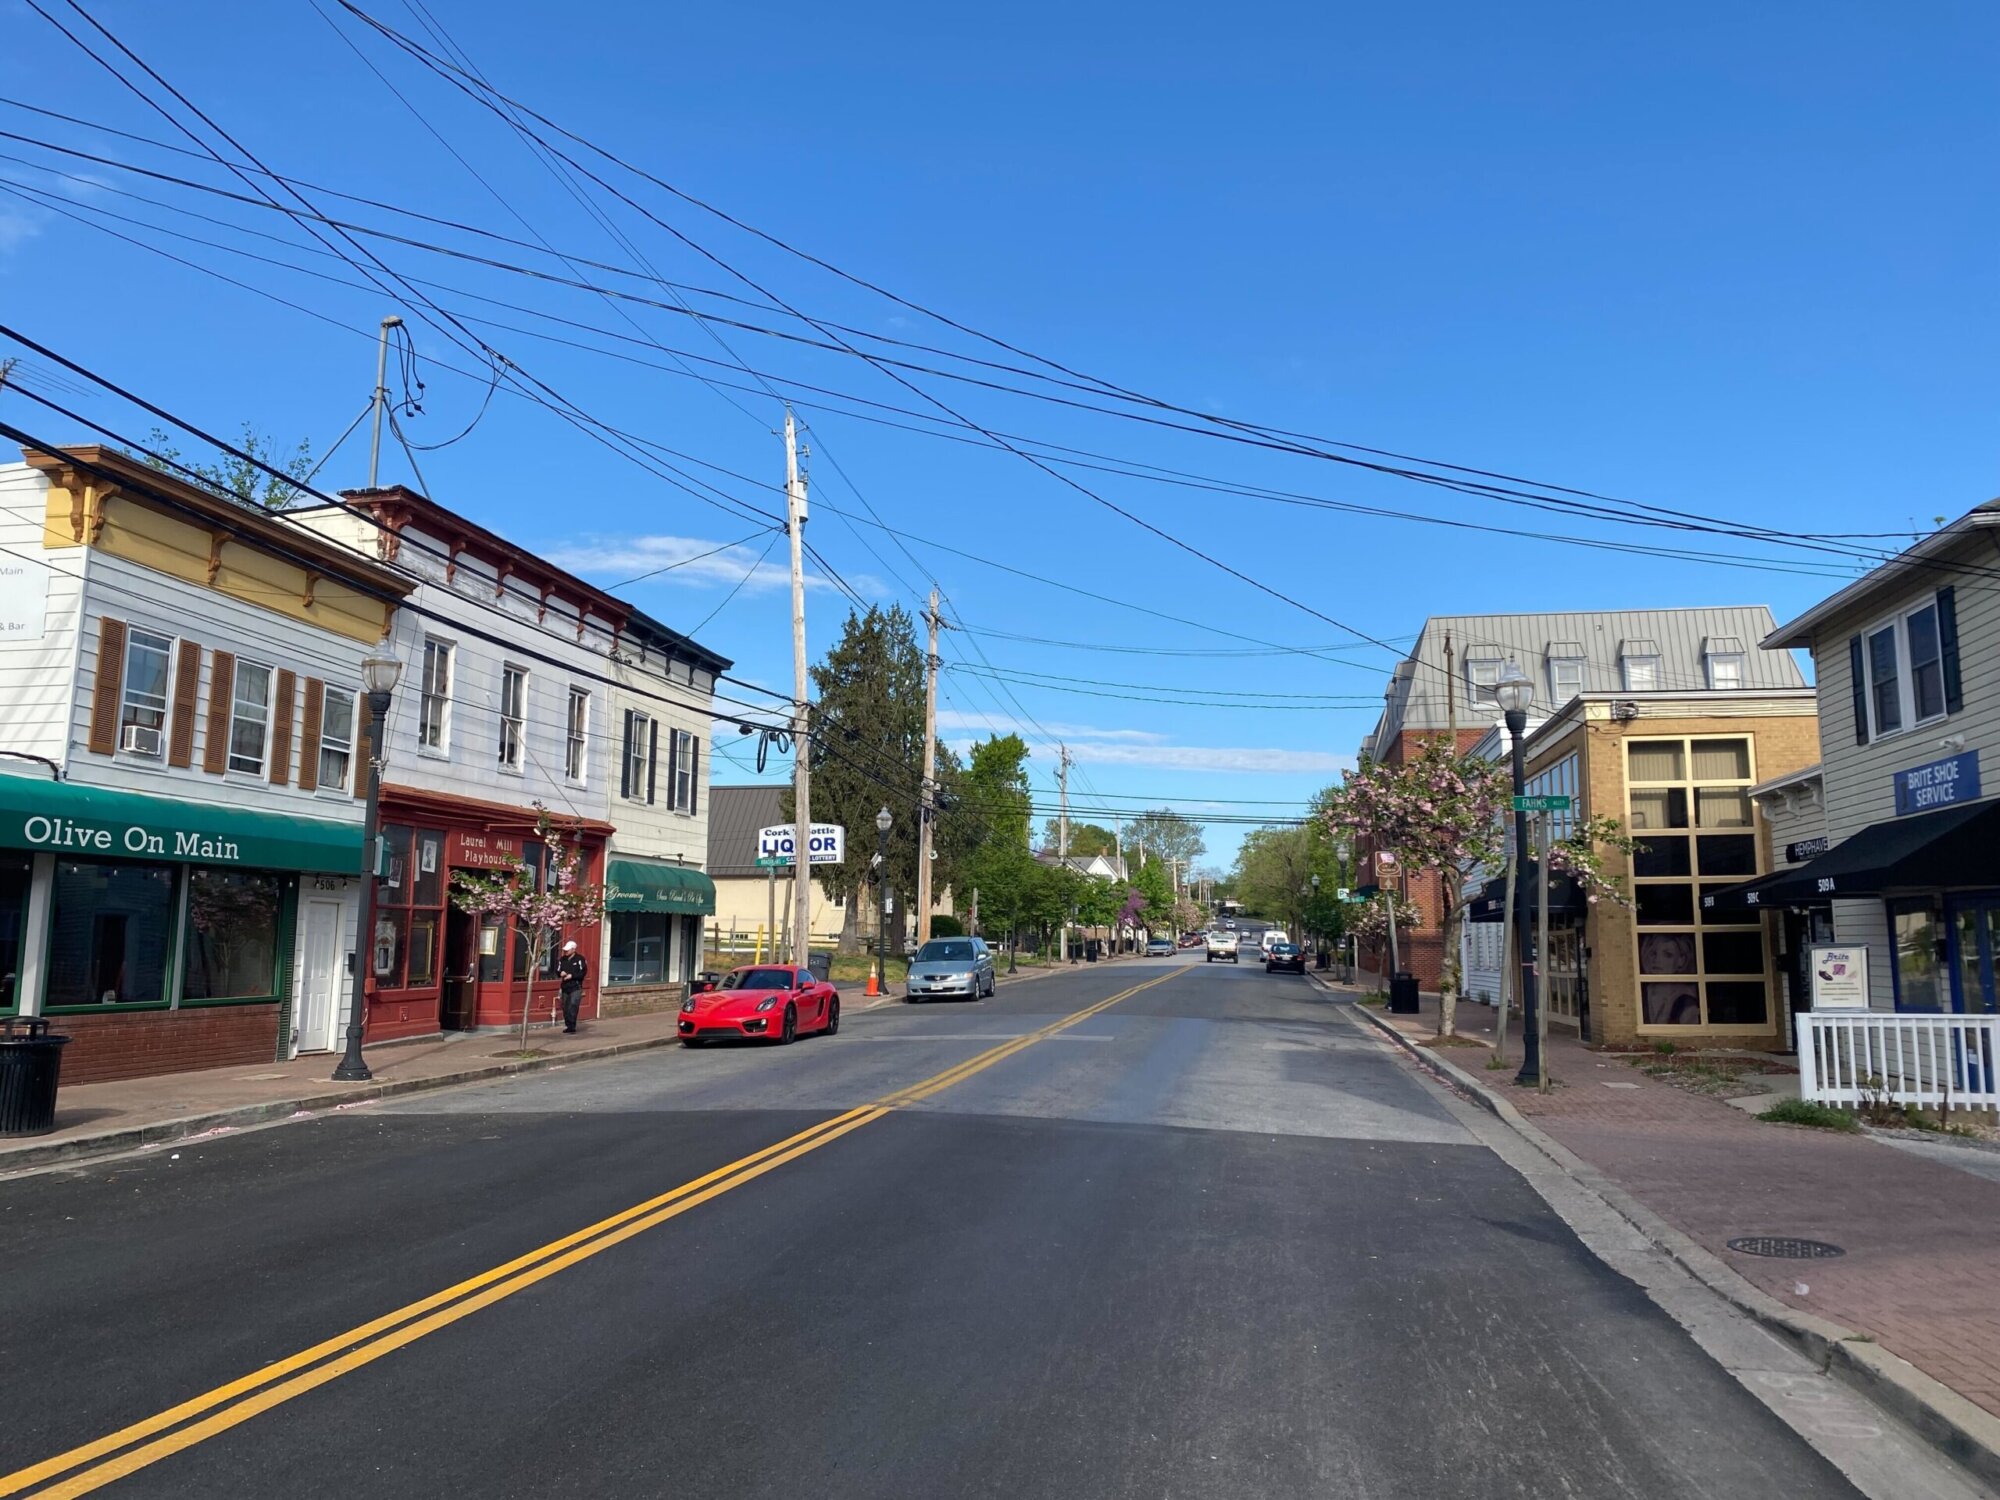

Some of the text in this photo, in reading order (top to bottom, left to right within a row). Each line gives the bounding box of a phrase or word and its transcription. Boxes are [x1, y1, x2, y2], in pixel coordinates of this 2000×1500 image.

[8, 622, 26, 631] Bar
[1908, 761, 1959, 789] BRITE SHOE
[1916, 782, 1955, 807] SERVICE
[24, 816, 239, 860] Olive On Main
[811, 827, 835, 835] ottle
[460, 833, 512, 851] Laurel Mill
[762, 837, 837, 854] LIQOR
[465, 849, 507, 866] Playhouse
[606, 886, 644, 903] Grooming
[1822, 952, 1849, 964] Brite
